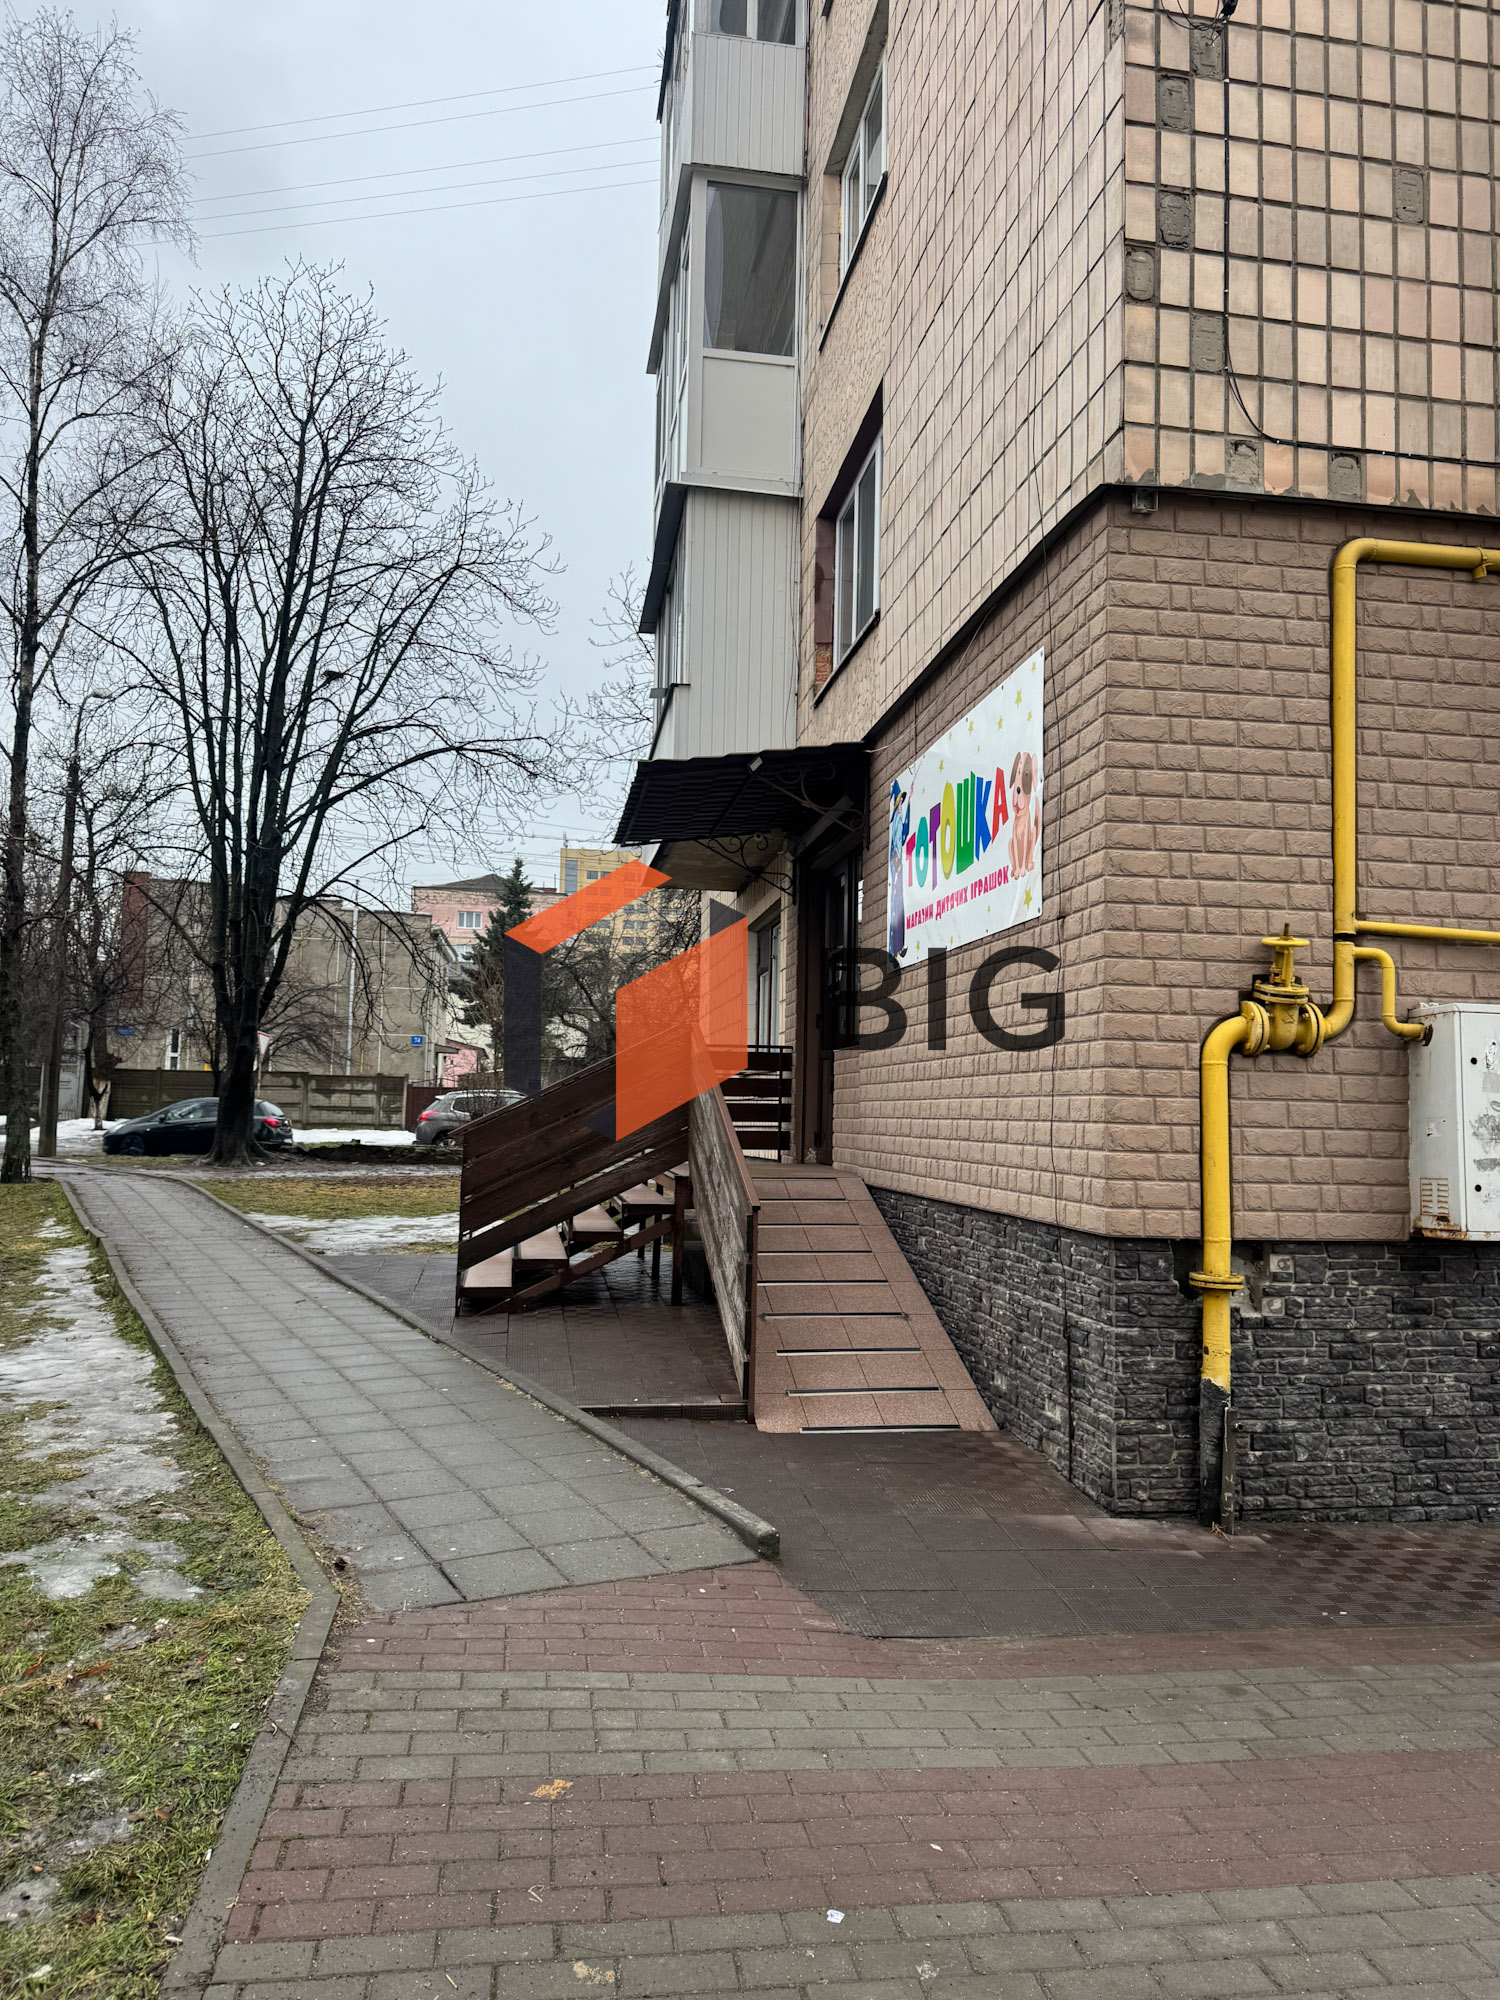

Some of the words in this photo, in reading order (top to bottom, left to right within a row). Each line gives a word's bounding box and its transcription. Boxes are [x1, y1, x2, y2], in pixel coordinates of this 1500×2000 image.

[905, 767, 1009, 891] ТОТОШКА
[906, 904, 933, 930] МАГАЗИН
[935, 886, 968, 920] ДИТЯЧИХ
[970, 865, 1009, 900] ІГРАШОК
